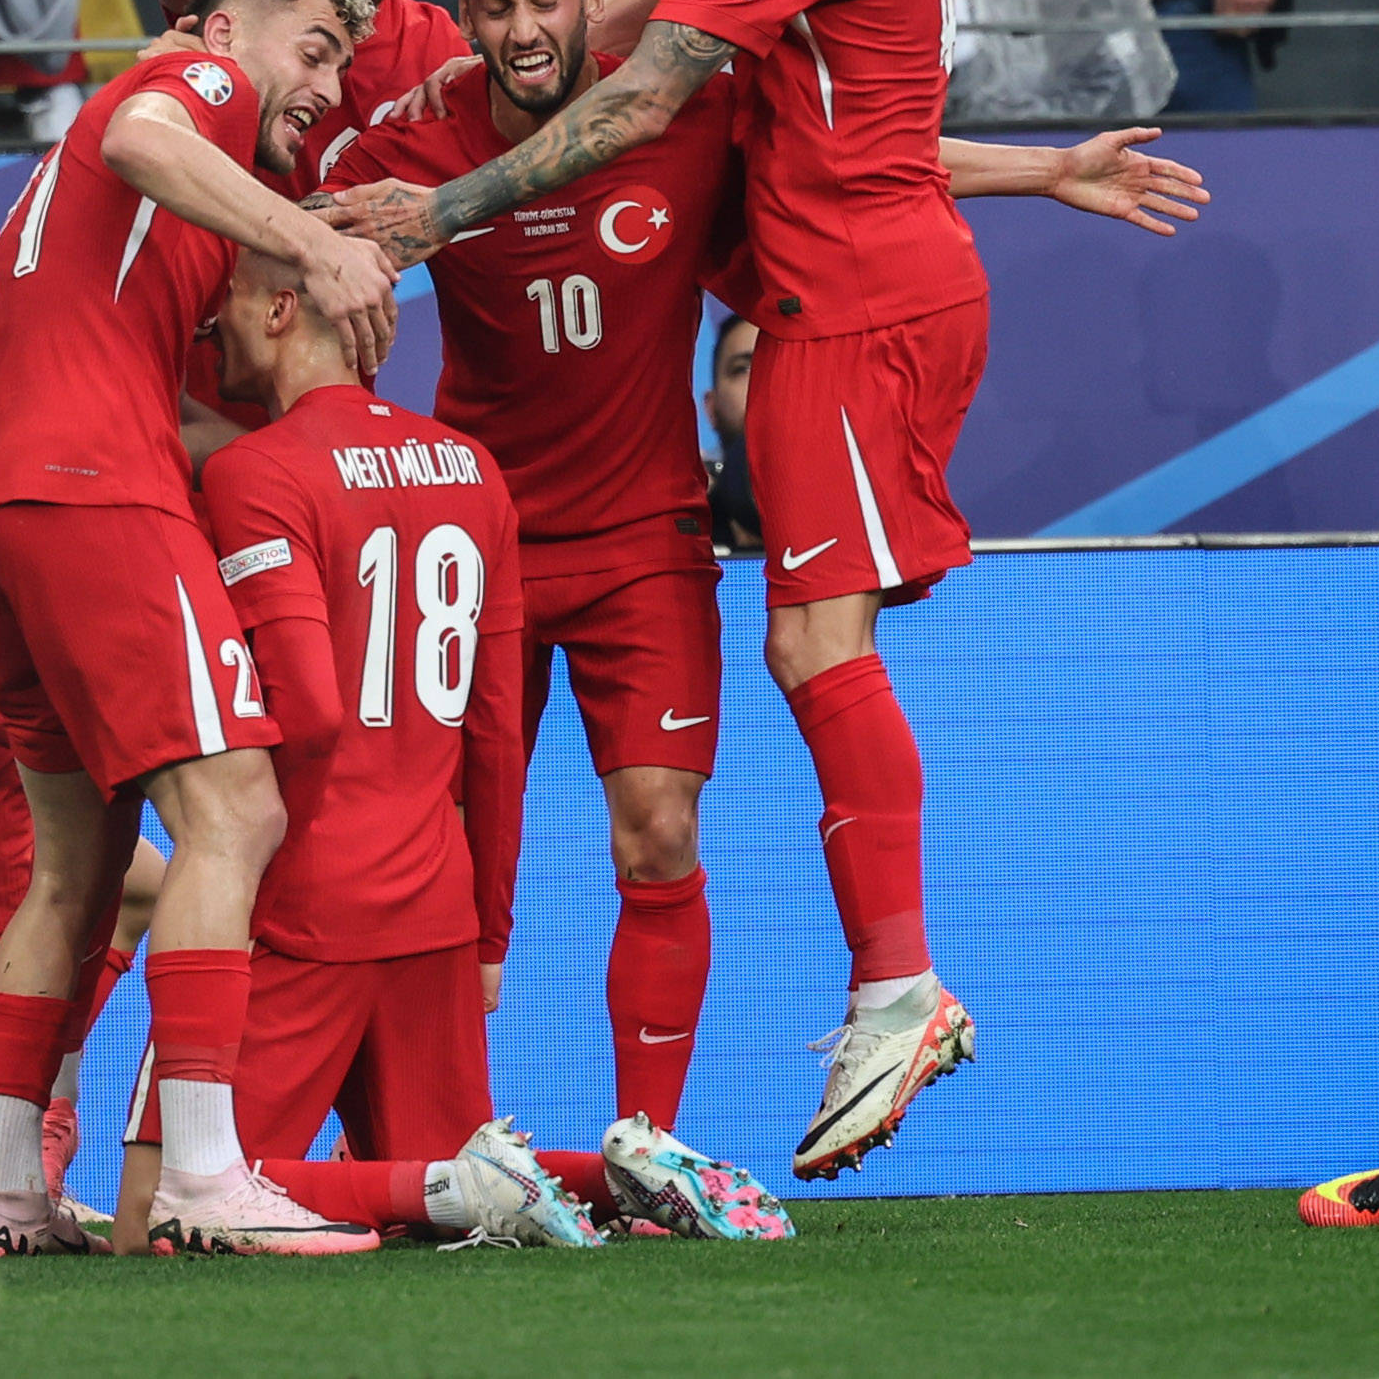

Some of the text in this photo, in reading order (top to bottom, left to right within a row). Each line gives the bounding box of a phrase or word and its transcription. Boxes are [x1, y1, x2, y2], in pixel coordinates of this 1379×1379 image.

[526, 274, 602, 353] 10
[332, 438, 484, 490] MERT MÜLDÜR
[358, 523, 484, 728] 18
[220, 638, 266, 720] 2
